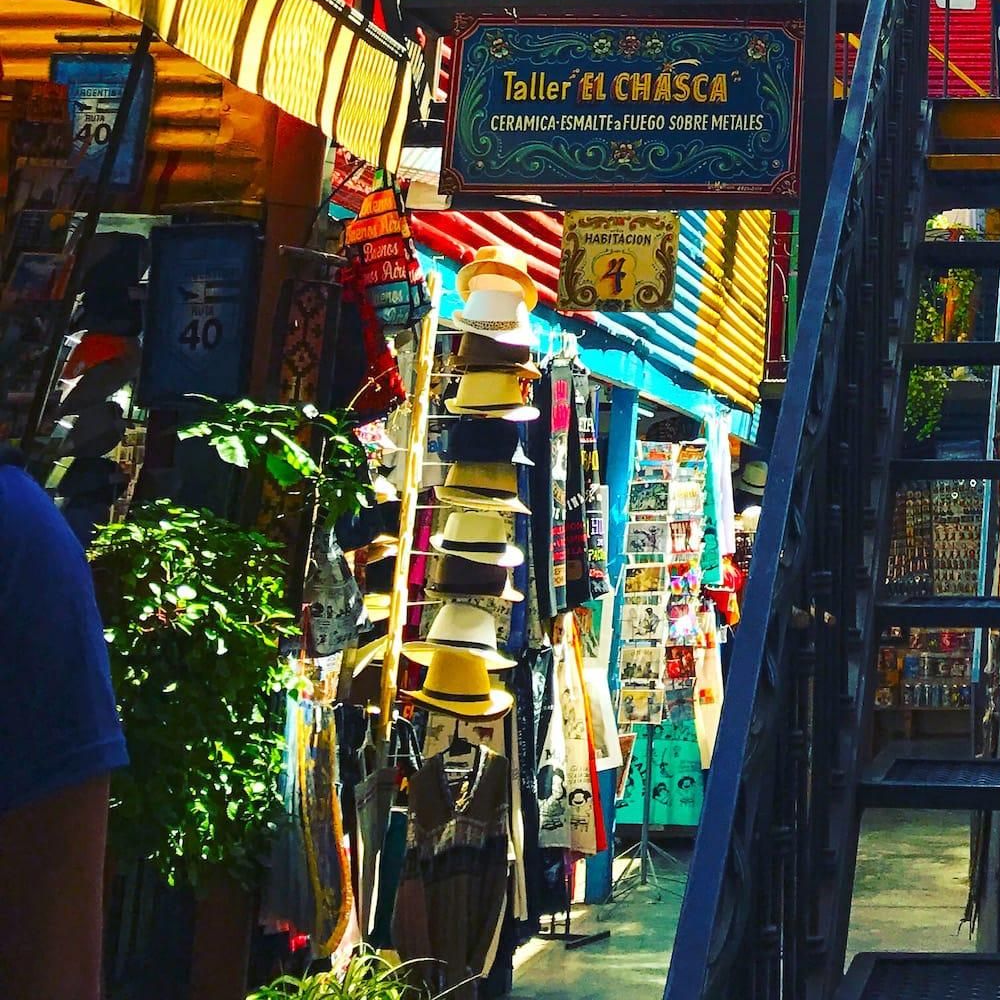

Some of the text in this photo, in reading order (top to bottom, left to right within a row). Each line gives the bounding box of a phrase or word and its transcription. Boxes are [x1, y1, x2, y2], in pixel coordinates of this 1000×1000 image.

[503, 71, 572, 101] Taller
[623, 114, 665, 131] FUEGO
[669, 114, 709, 131] SOBRE
[711, 114, 764, 131] METALES
[74, 123, 112, 146] 40
[585, 232, 652, 246] HABITACION
[362, 242, 399, 262] Buenos
[600, 257, 627, 296] 4
[178, 318, 223, 350] 40
